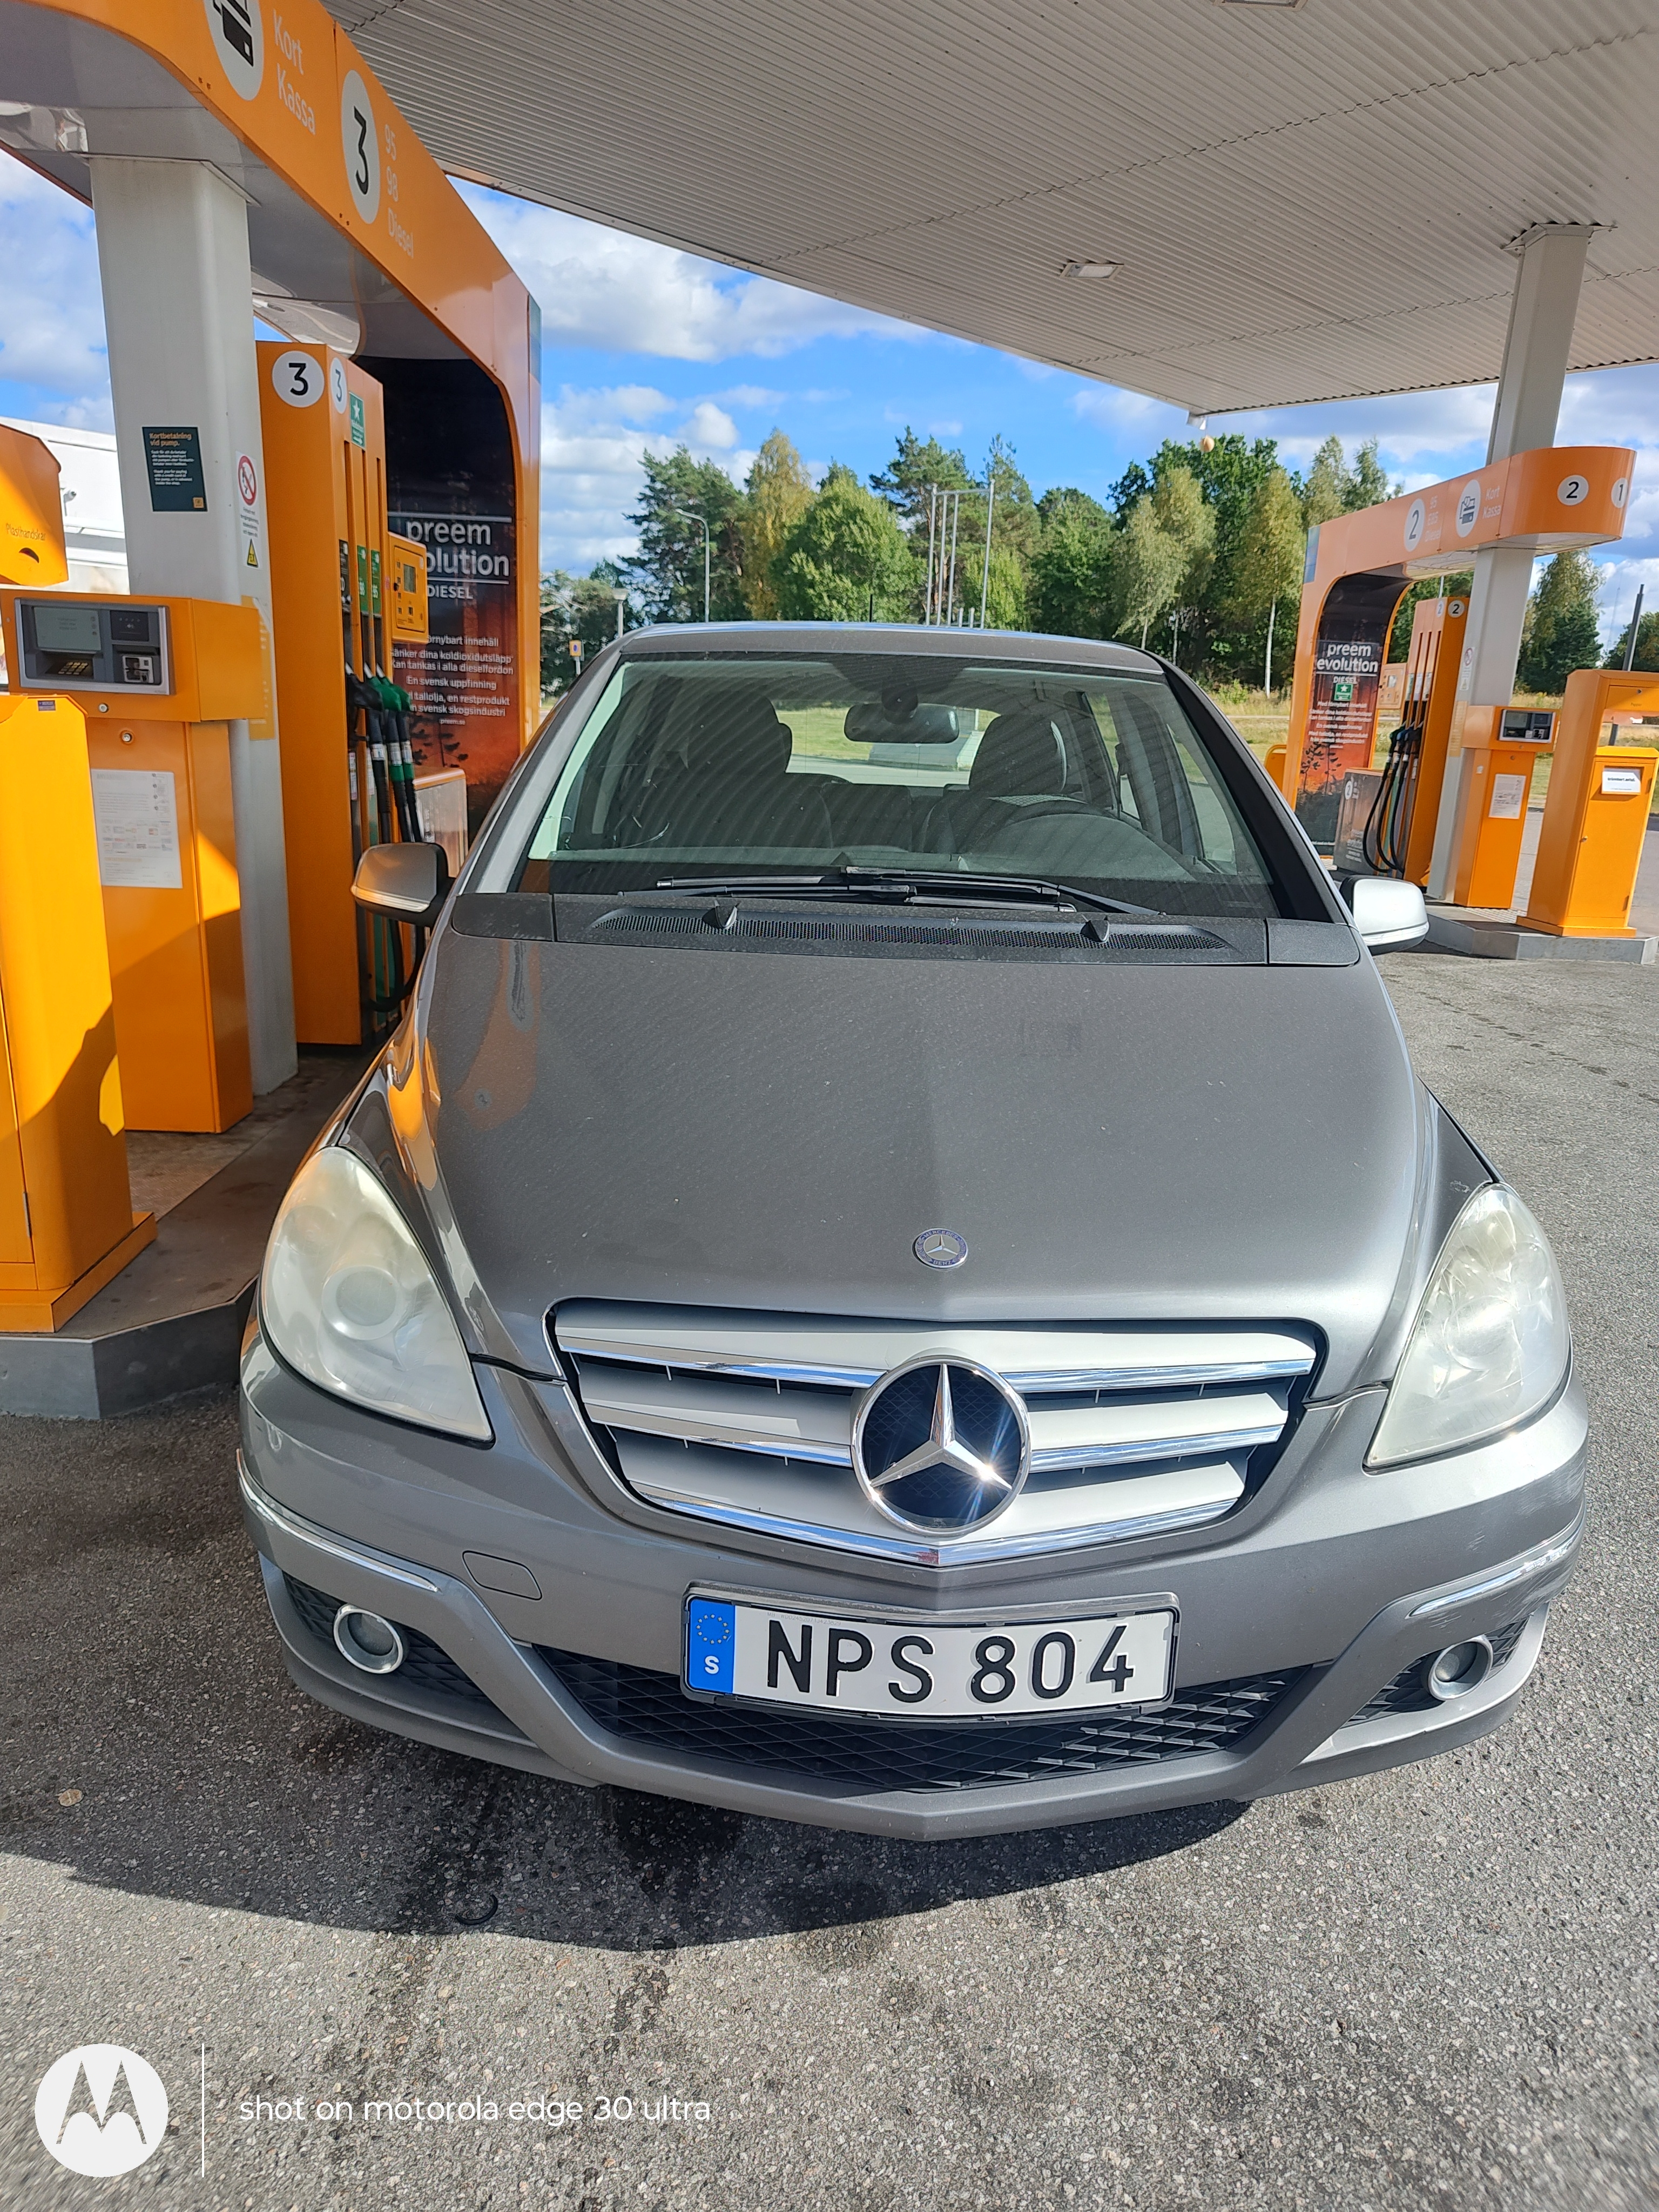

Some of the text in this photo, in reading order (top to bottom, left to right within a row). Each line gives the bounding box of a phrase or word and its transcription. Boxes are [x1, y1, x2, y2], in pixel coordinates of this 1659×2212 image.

[273, 9, 304, 75] Kort
[277, 63, 315, 135] Kassa
[353, 105, 369, 195] 3
[385, 124, 396, 161] 95
[387, 166, 398, 202] 98
[388, 207, 414, 259] Diesel
[289, 363, 308, 396] 3
[335, 369, 342, 402] 3
[1486, 486, 1500, 500] Kort
[1566, 481, 1579, 498] 2
[1618, 484, 1624, 501] 1
[1482, 505, 1501, 519] Kassa
[406, 520, 491, 545] preem
[1409, 509, 1419, 539] 2
[427, 547, 509, 577] olution
[428, 584, 473, 599] DIESEL
[1452, 604, 1460, 614] 2
[428, 635, 498, 647] örnybart innehåll
[419, 650, 438, 659] dina
[1327, 644, 1372, 657] preem
[408, 660, 436, 670] tankas
[442, 663, 458, 672] alla
[459, 664, 514, 675] dieselfordon
[1317, 657, 1378, 672] evolution
[406, 676, 497, 690] En svensk uppfinning
[460, 695, 510, 705] restprodukt
[419, 704, 447, 713] svensk
[448, 705, 505, 717] skogsindustri
[923, 1230, 959, 1239] MERCEDES
[704, 1655, 719, 1675] S
[767, 1620, 1134, 1703] NPS 804
